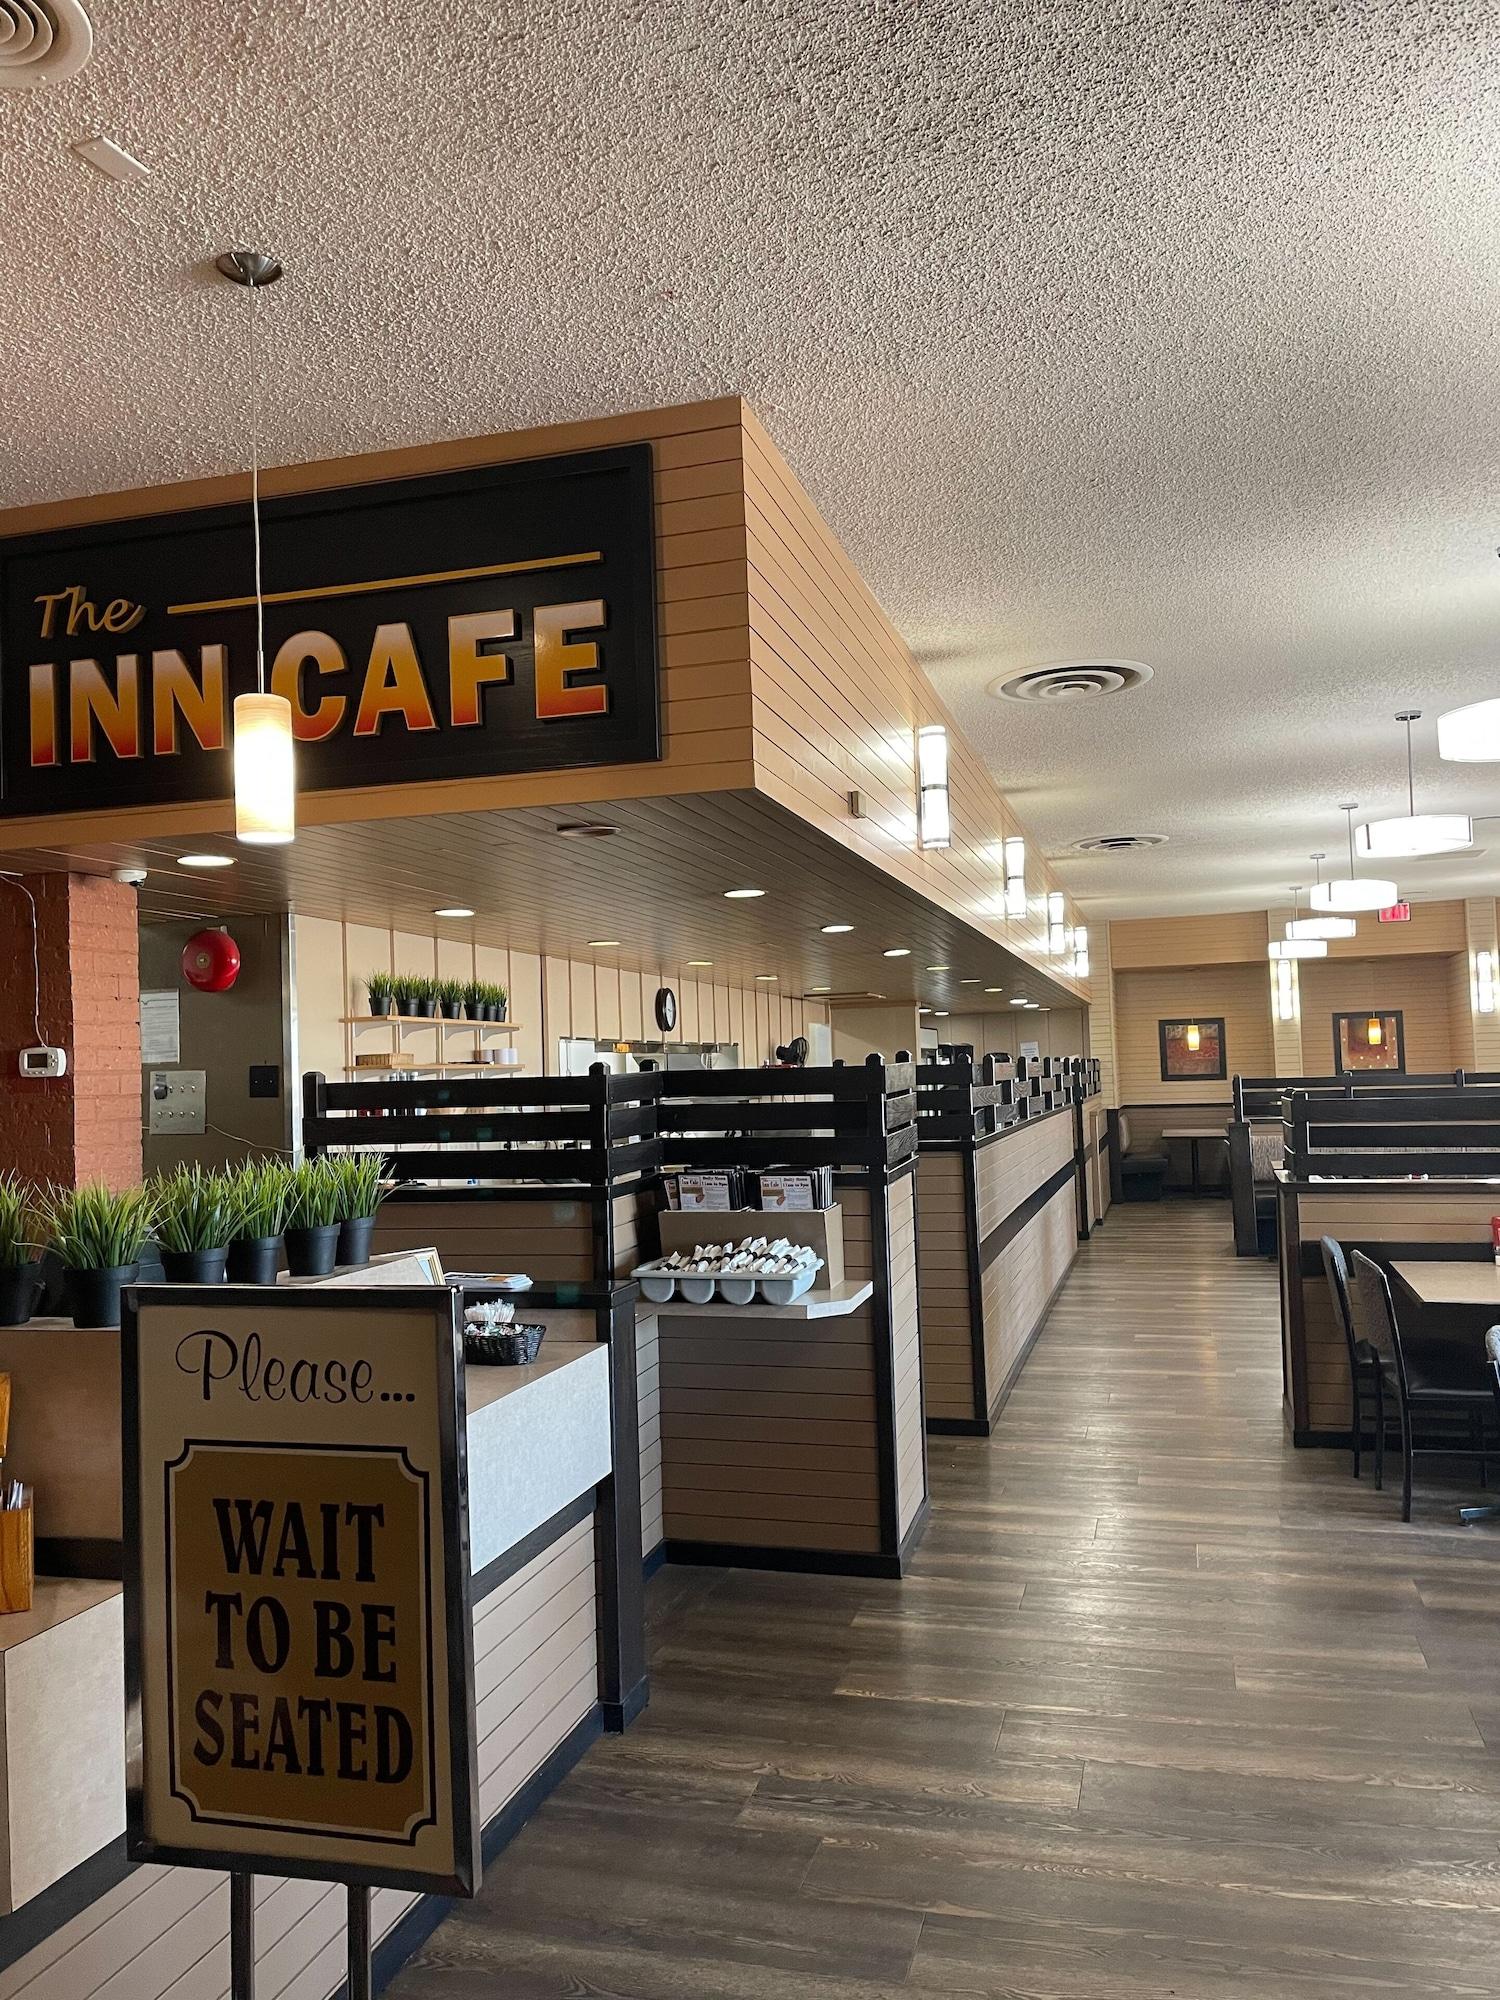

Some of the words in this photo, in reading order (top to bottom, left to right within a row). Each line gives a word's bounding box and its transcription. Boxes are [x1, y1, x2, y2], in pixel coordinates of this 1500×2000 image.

[34, 585, 146, 638] The
[29, 644, 229, 767] INN
[270, 599, 608, 742] CAFE
[175, 1329, 416, 1402] Please...
[212, 1498, 385, 1583] WAIT
[205, 1590, 291, 1676] TO
[313, 1600, 397, 1683] BE
[193, 1689, 414, 1784] SEATED
